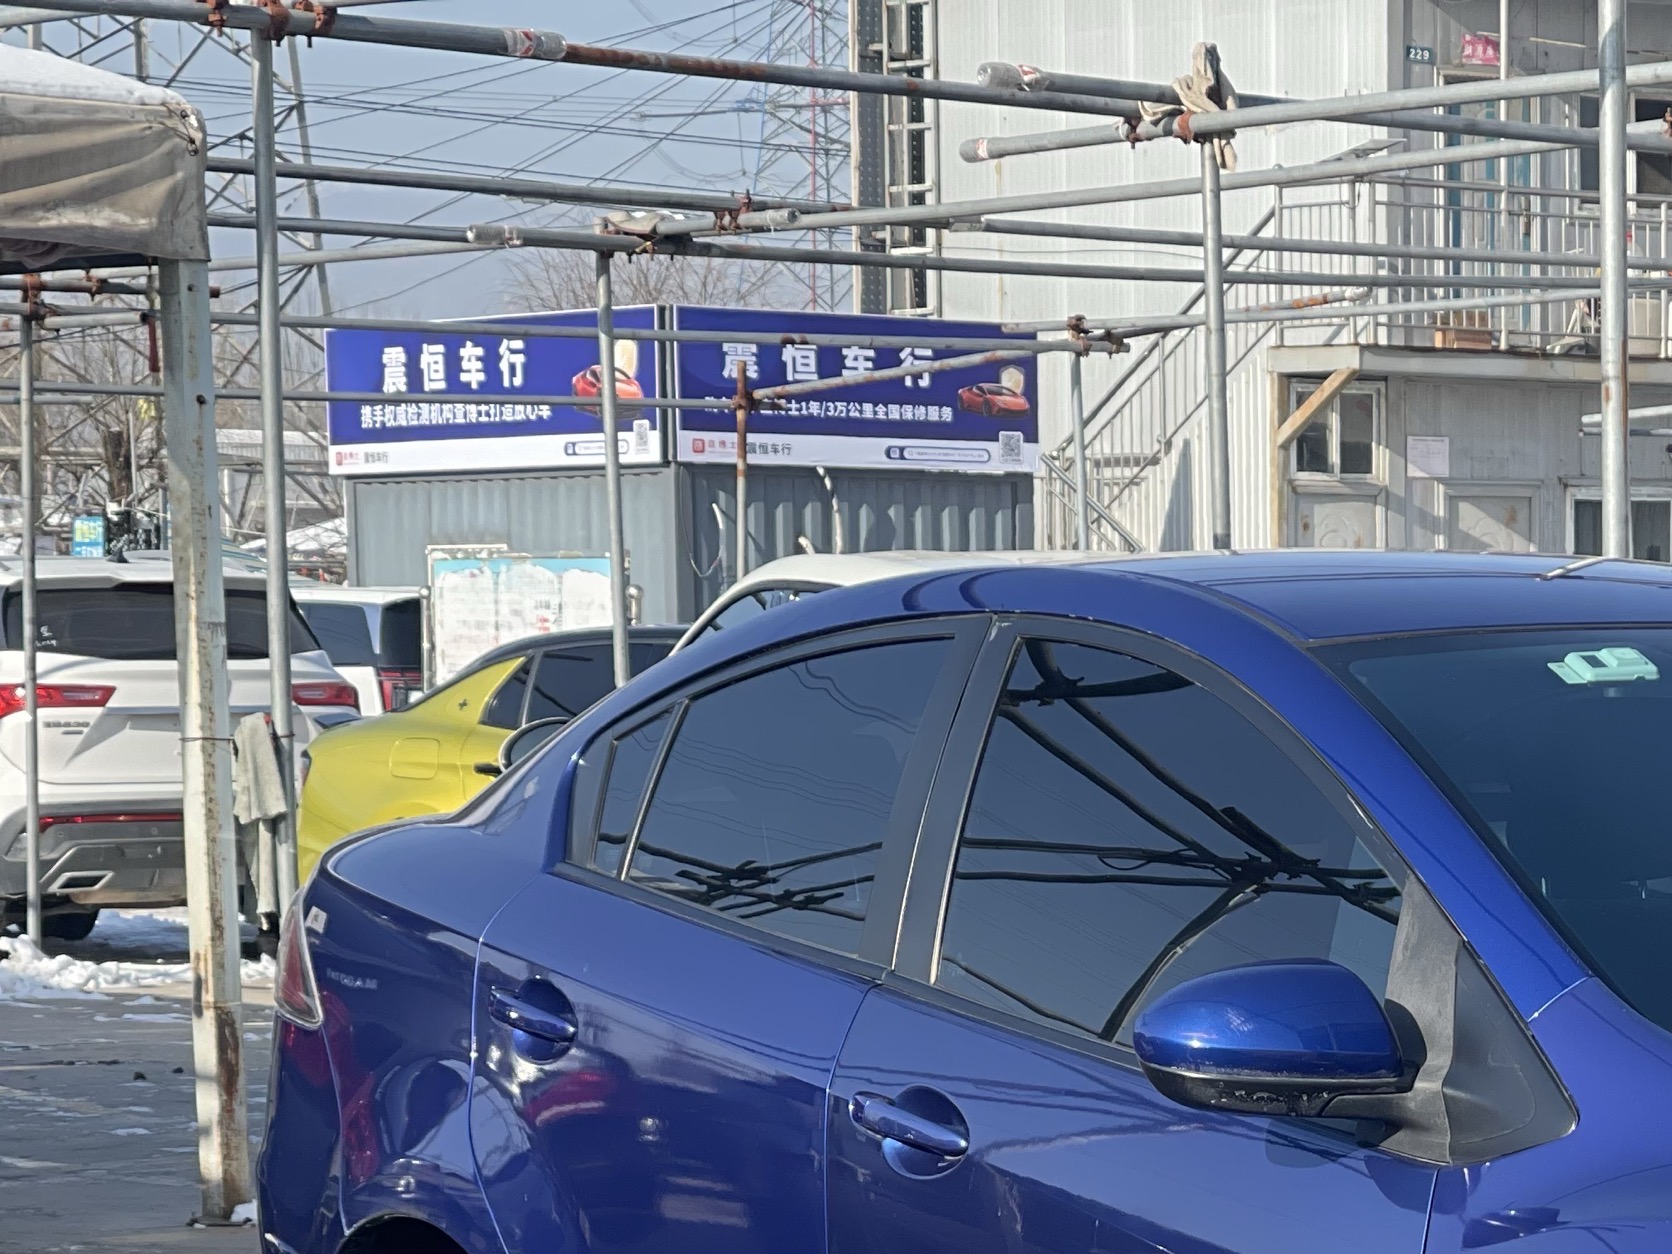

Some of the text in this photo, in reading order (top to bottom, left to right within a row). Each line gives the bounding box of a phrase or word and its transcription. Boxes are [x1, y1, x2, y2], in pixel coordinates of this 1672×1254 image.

[1409, 48, 1430, 60] 229
[382, 339, 527, 394] 震恒车行
[722, 342, 935, 388] 震恒车行
